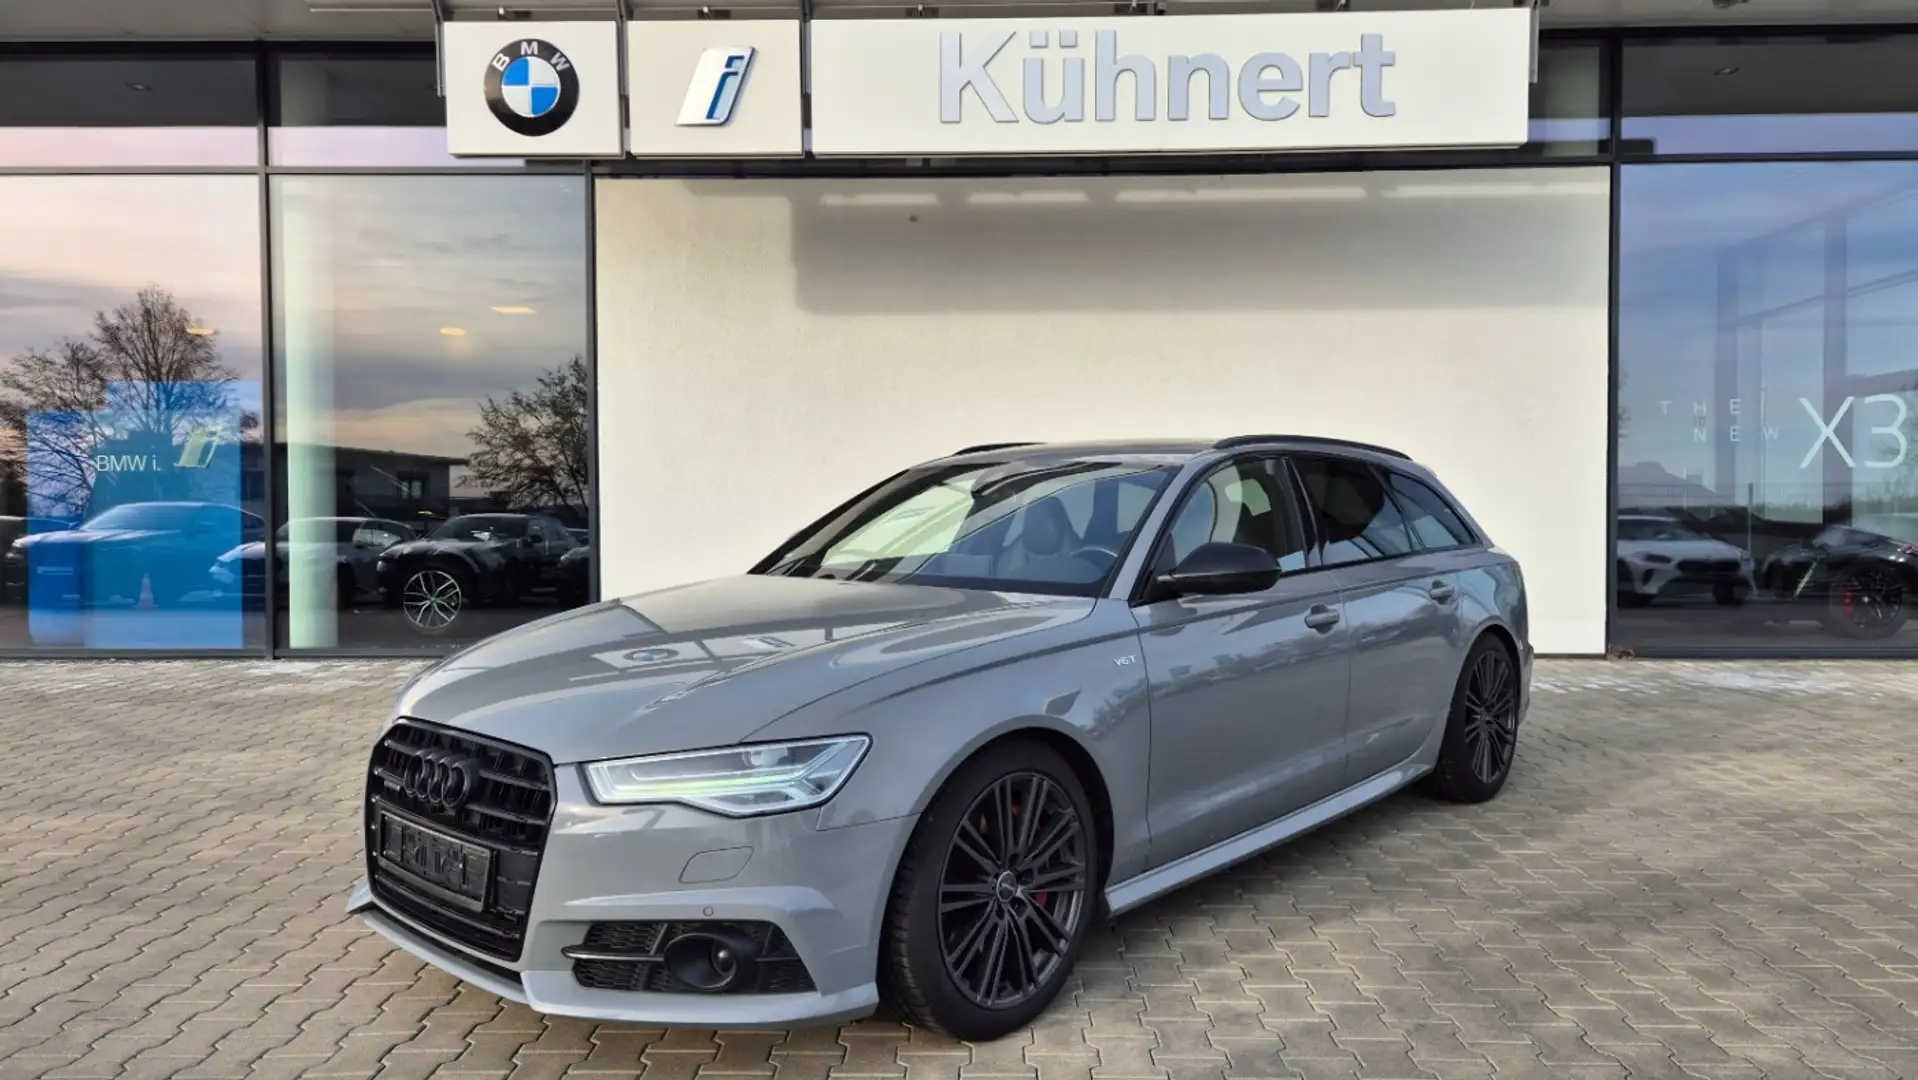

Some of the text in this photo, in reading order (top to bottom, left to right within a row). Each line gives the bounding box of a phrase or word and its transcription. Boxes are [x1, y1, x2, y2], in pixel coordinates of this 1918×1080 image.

[492, 40, 571, 72] BMW
[939, 30, 1397, 125] Kühnert
[1658, 398, 1742, 417] THE
[1693, 425, 1780, 443] NEW
[1799, 393, 1909, 470] X3
[97, 454, 148, 472] BMW
[1113, 654, 1136, 668] V6T
